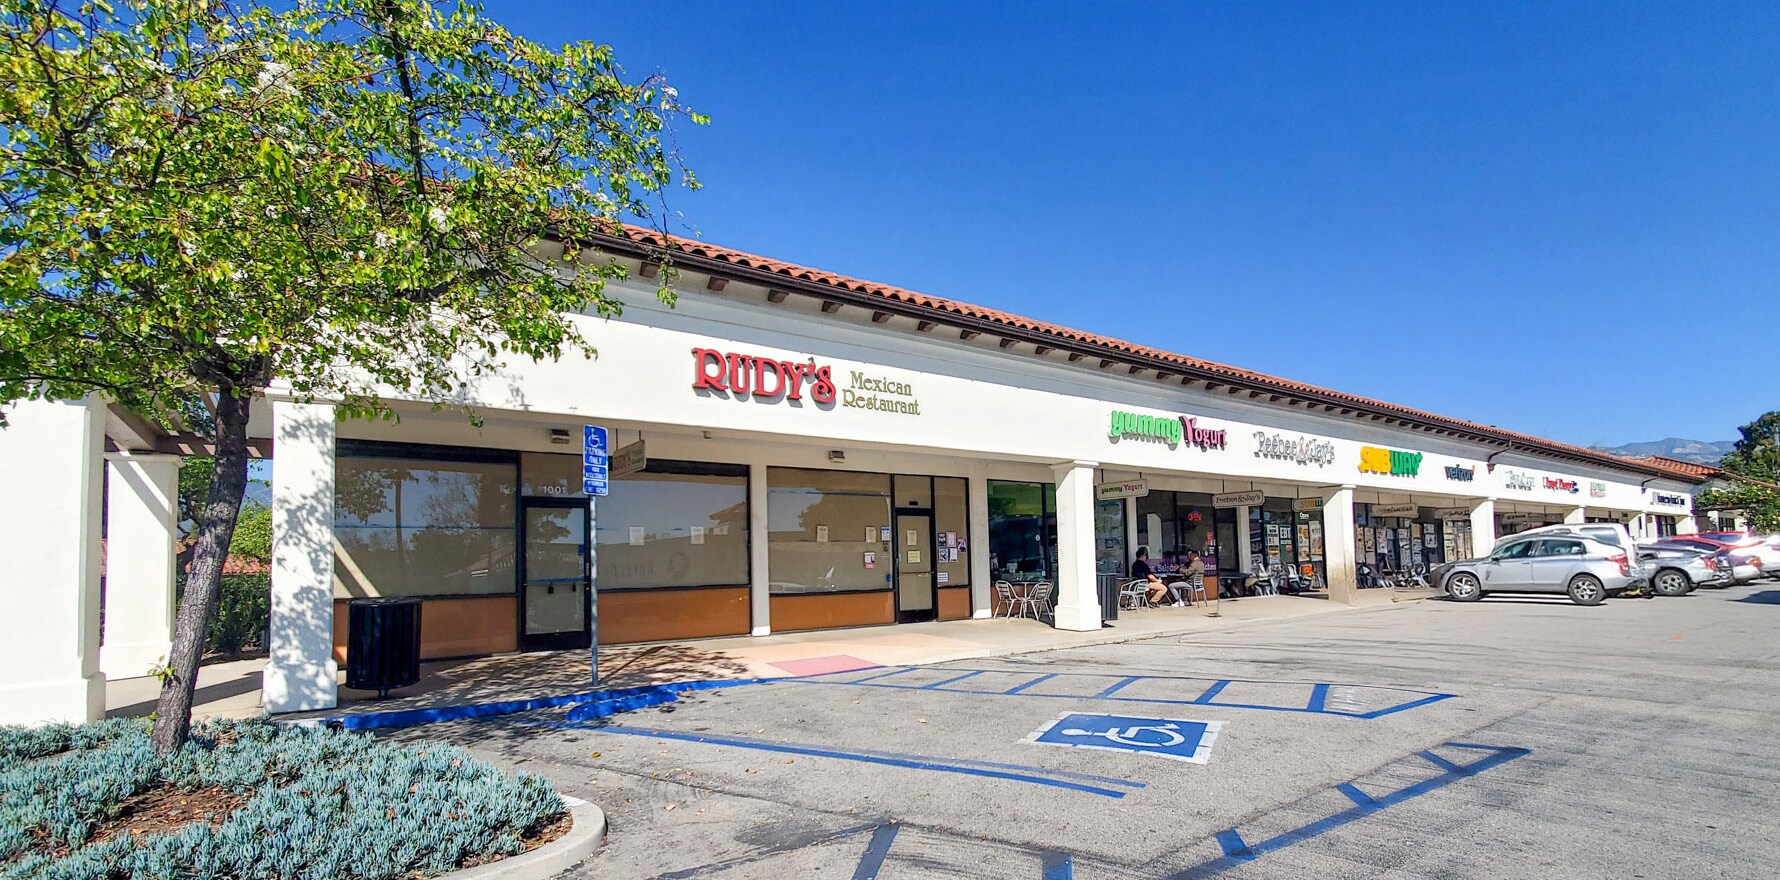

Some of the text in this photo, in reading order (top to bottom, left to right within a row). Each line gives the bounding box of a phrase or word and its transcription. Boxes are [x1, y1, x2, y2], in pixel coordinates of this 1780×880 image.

[691, 348, 836, 404] RUDY'S
[850, 371, 912, 396] Mexican
[842, 389, 921, 415] Restaurant
[1110, 410, 1227, 446] yummy Yogurt
[1359, 446, 1423, 477] SUBWAY
[1445, 464, 1474, 482] verizon
[543, 486, 566, 494] 1001
[1101, 483, 1143, 494] yummy Yogurt
